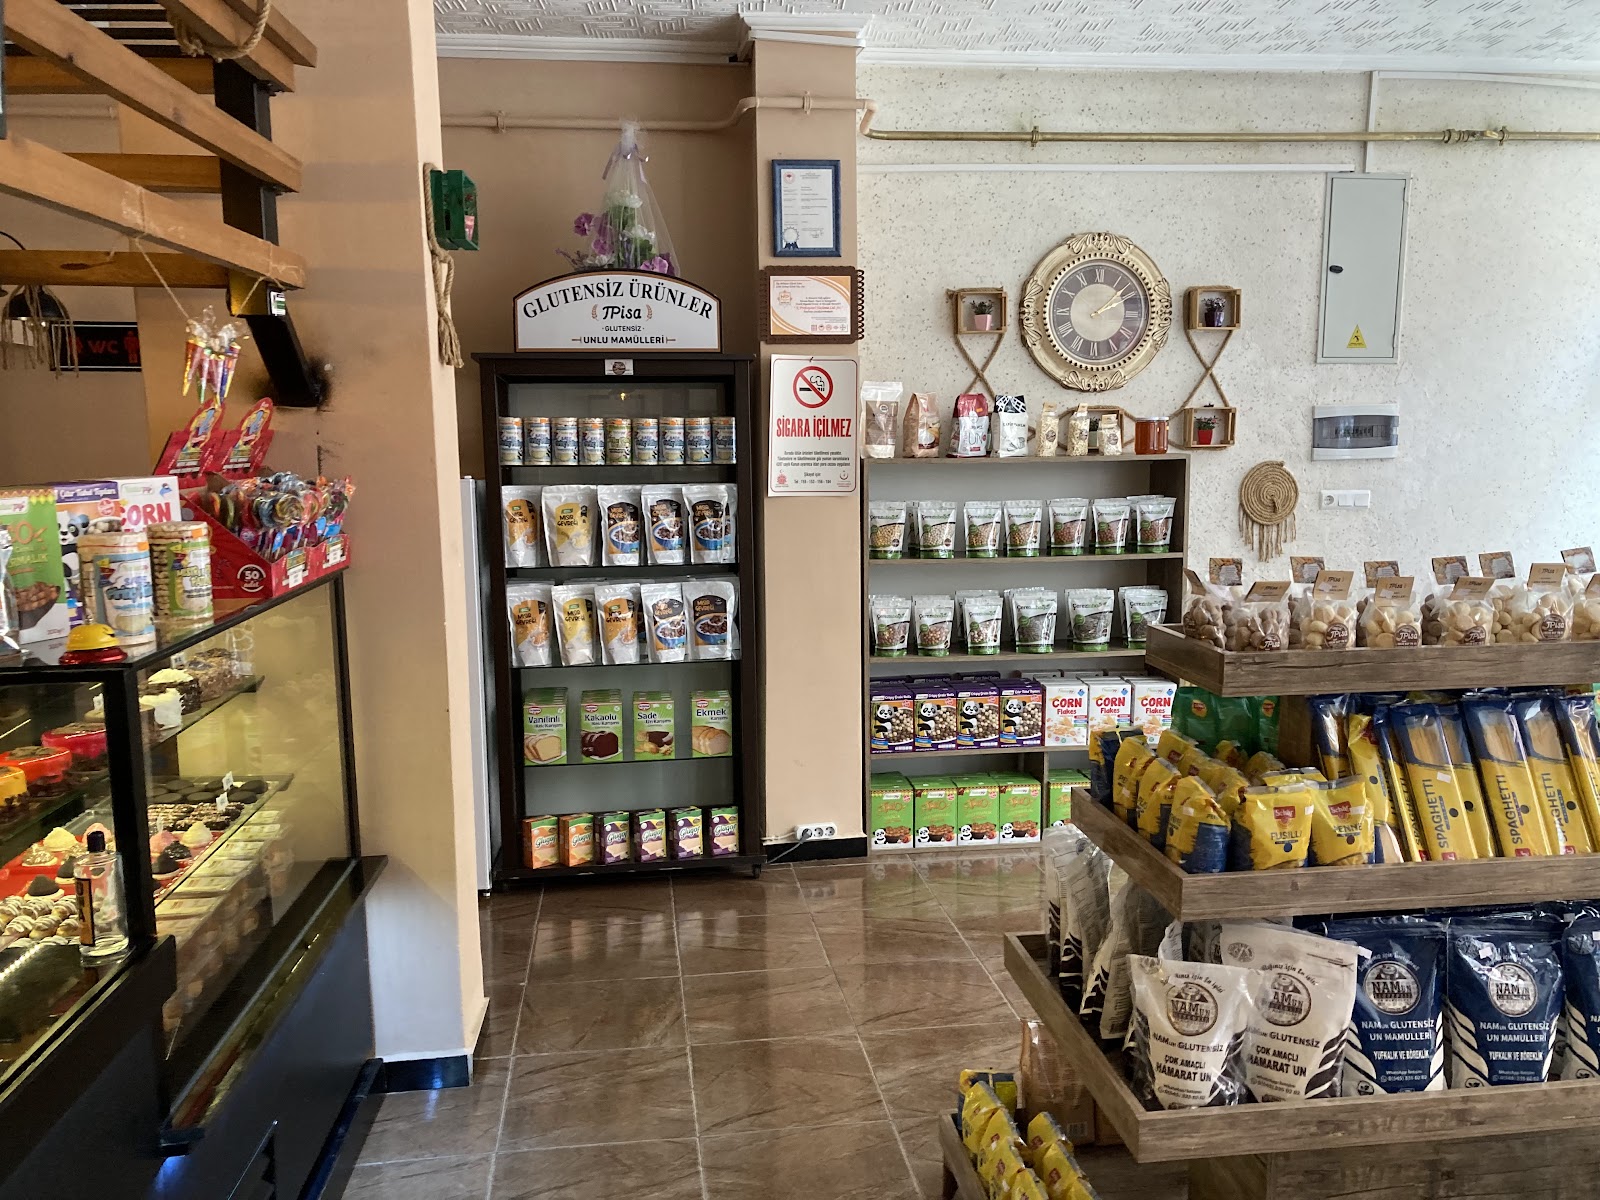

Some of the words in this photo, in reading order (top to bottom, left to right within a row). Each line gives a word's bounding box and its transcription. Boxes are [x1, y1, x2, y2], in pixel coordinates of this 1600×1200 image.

[522, 278, 624, 319] GLUTENSİZ
[629, 278, 713, 319] ÜRÜNLER
[583, 336, 609, 344] UNLU
[611, 335, 665, 344] MAMÜLLERİ
[87, 340, 118, 353] WC
[776, 415, 810, 438] SİGARA
[813, 415, 852, 440] İÇİLMEZ
[244, 570, 260, 580] 50
[1052, 698, 1082, 708] CORN
[1095, 697, 1126, 707] CORN
[1140, 697, 1171, 707] CORN
[584, 713, 617, 722] Kakaolu
[637, 712, 657, 720] Sade
[696, 708, 726, 717] Ekmek
[529, 715, 560, 724] Vanilinli
[1422, 779, 1449, 849] SPAGHETTI
[1495, 774, 1523, 845] SPAGHETTI
[1390, 1019, 1435, 1029] GLUTENSİZ
[1507, 1020, 1550, 1030] GLUTENSİZ
[1269, 1031, 1321, 1048] GLUTENSİZ
[1369, 1033, 1382, 1041] UN
[1486, 1034, 1499, 1042] UN
[1177, 1041, 1224, 1052] GLUTENSİZ
[1256, 1045, 1270, 1055] ÇOK
[1271, 1048, 1299, 1062] AMAÇLI
[1399, 1050, 1406, 1060] VE
[1165, 1055, 1178, 1065] ÇOK
[1179, 1057, 1205, 1070] AMAÇLI
[1156, 1062, 1198, 1082] HAMARAT
[1199, 1072, 1212, 1082] UN
[1293, 1065, 1307, 1077] UN
